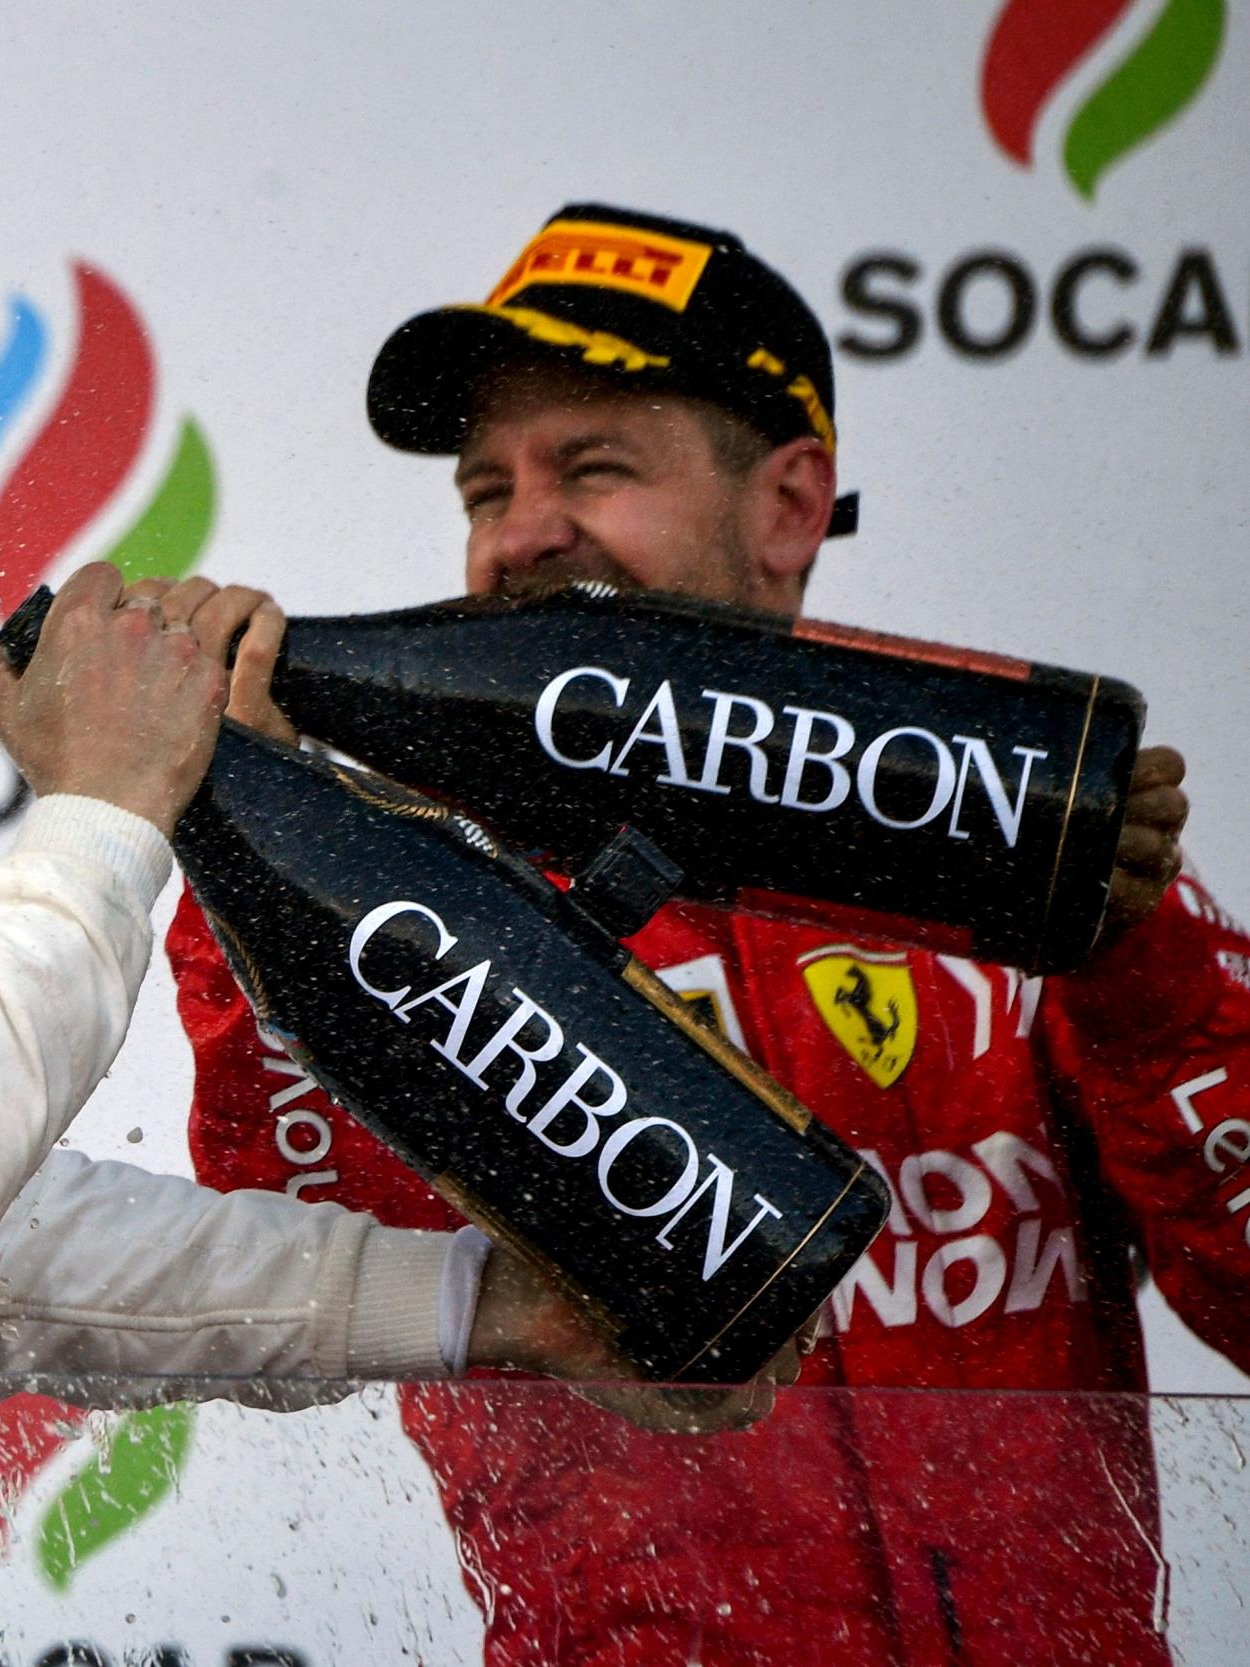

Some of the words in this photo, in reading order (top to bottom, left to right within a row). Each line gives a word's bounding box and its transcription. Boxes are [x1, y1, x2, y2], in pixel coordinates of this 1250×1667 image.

[836, 247, 1242, 362] SOCA
[535, 667, 1049, 848] CARBON
[349, 900, 783, 1282] CARBON
